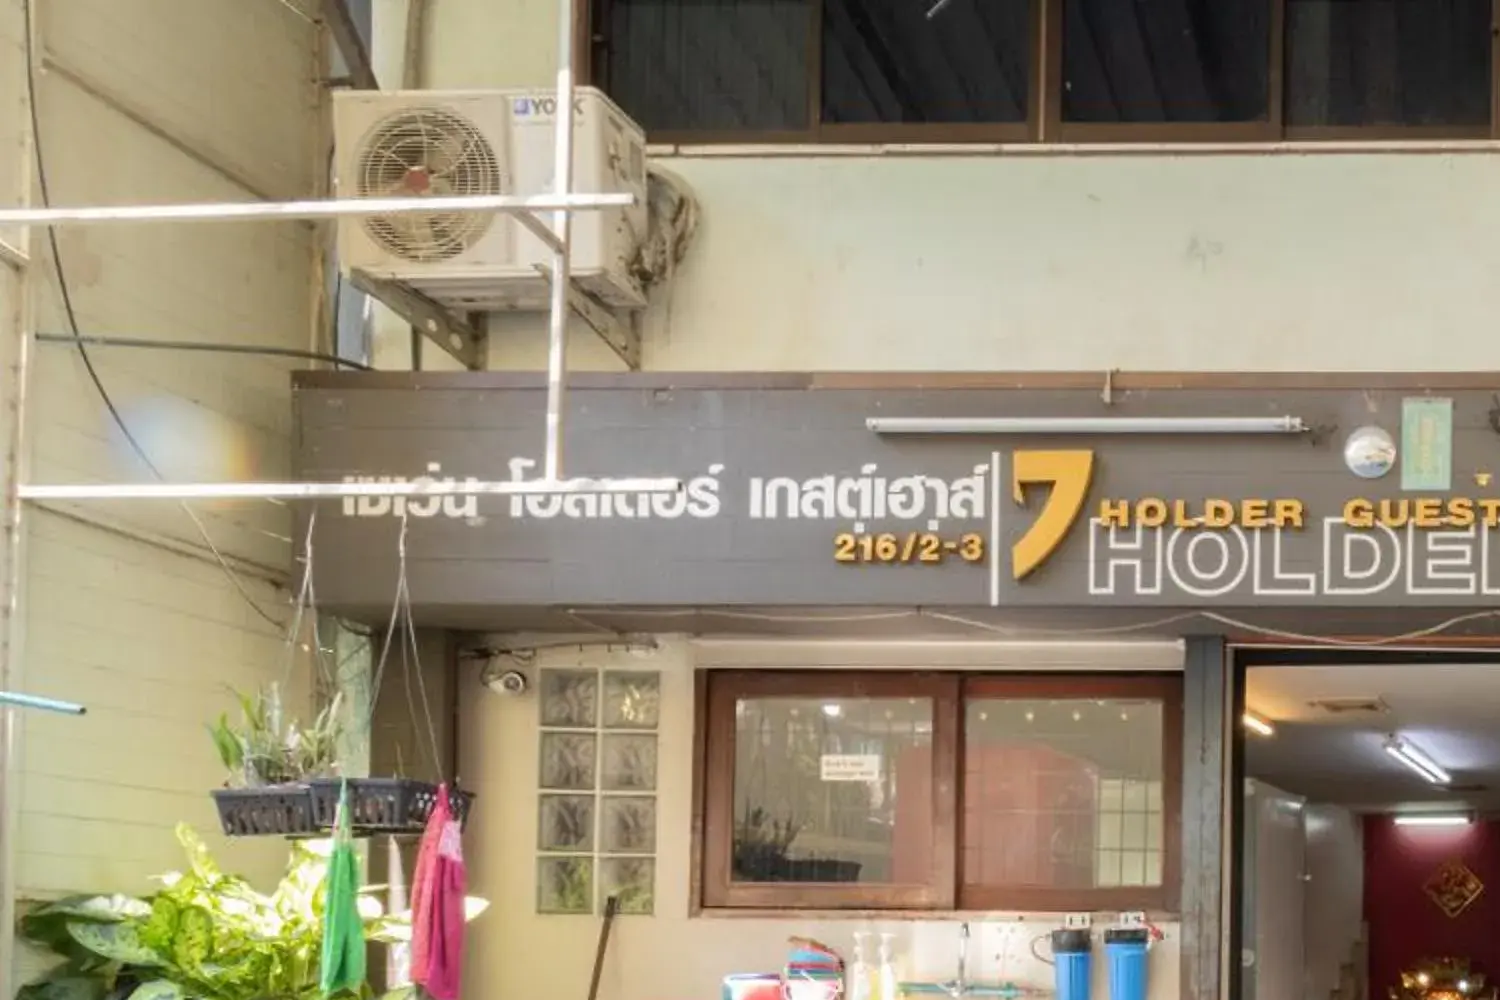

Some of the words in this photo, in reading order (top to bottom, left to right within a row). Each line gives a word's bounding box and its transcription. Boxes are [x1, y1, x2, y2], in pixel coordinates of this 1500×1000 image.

[532, 97, 585, 116] YOK
[1012, 450, 1095, 582] 7
[1100, 497, 1304, 528] HOLDER
[834, 532, 982, 562] 216/2-3
